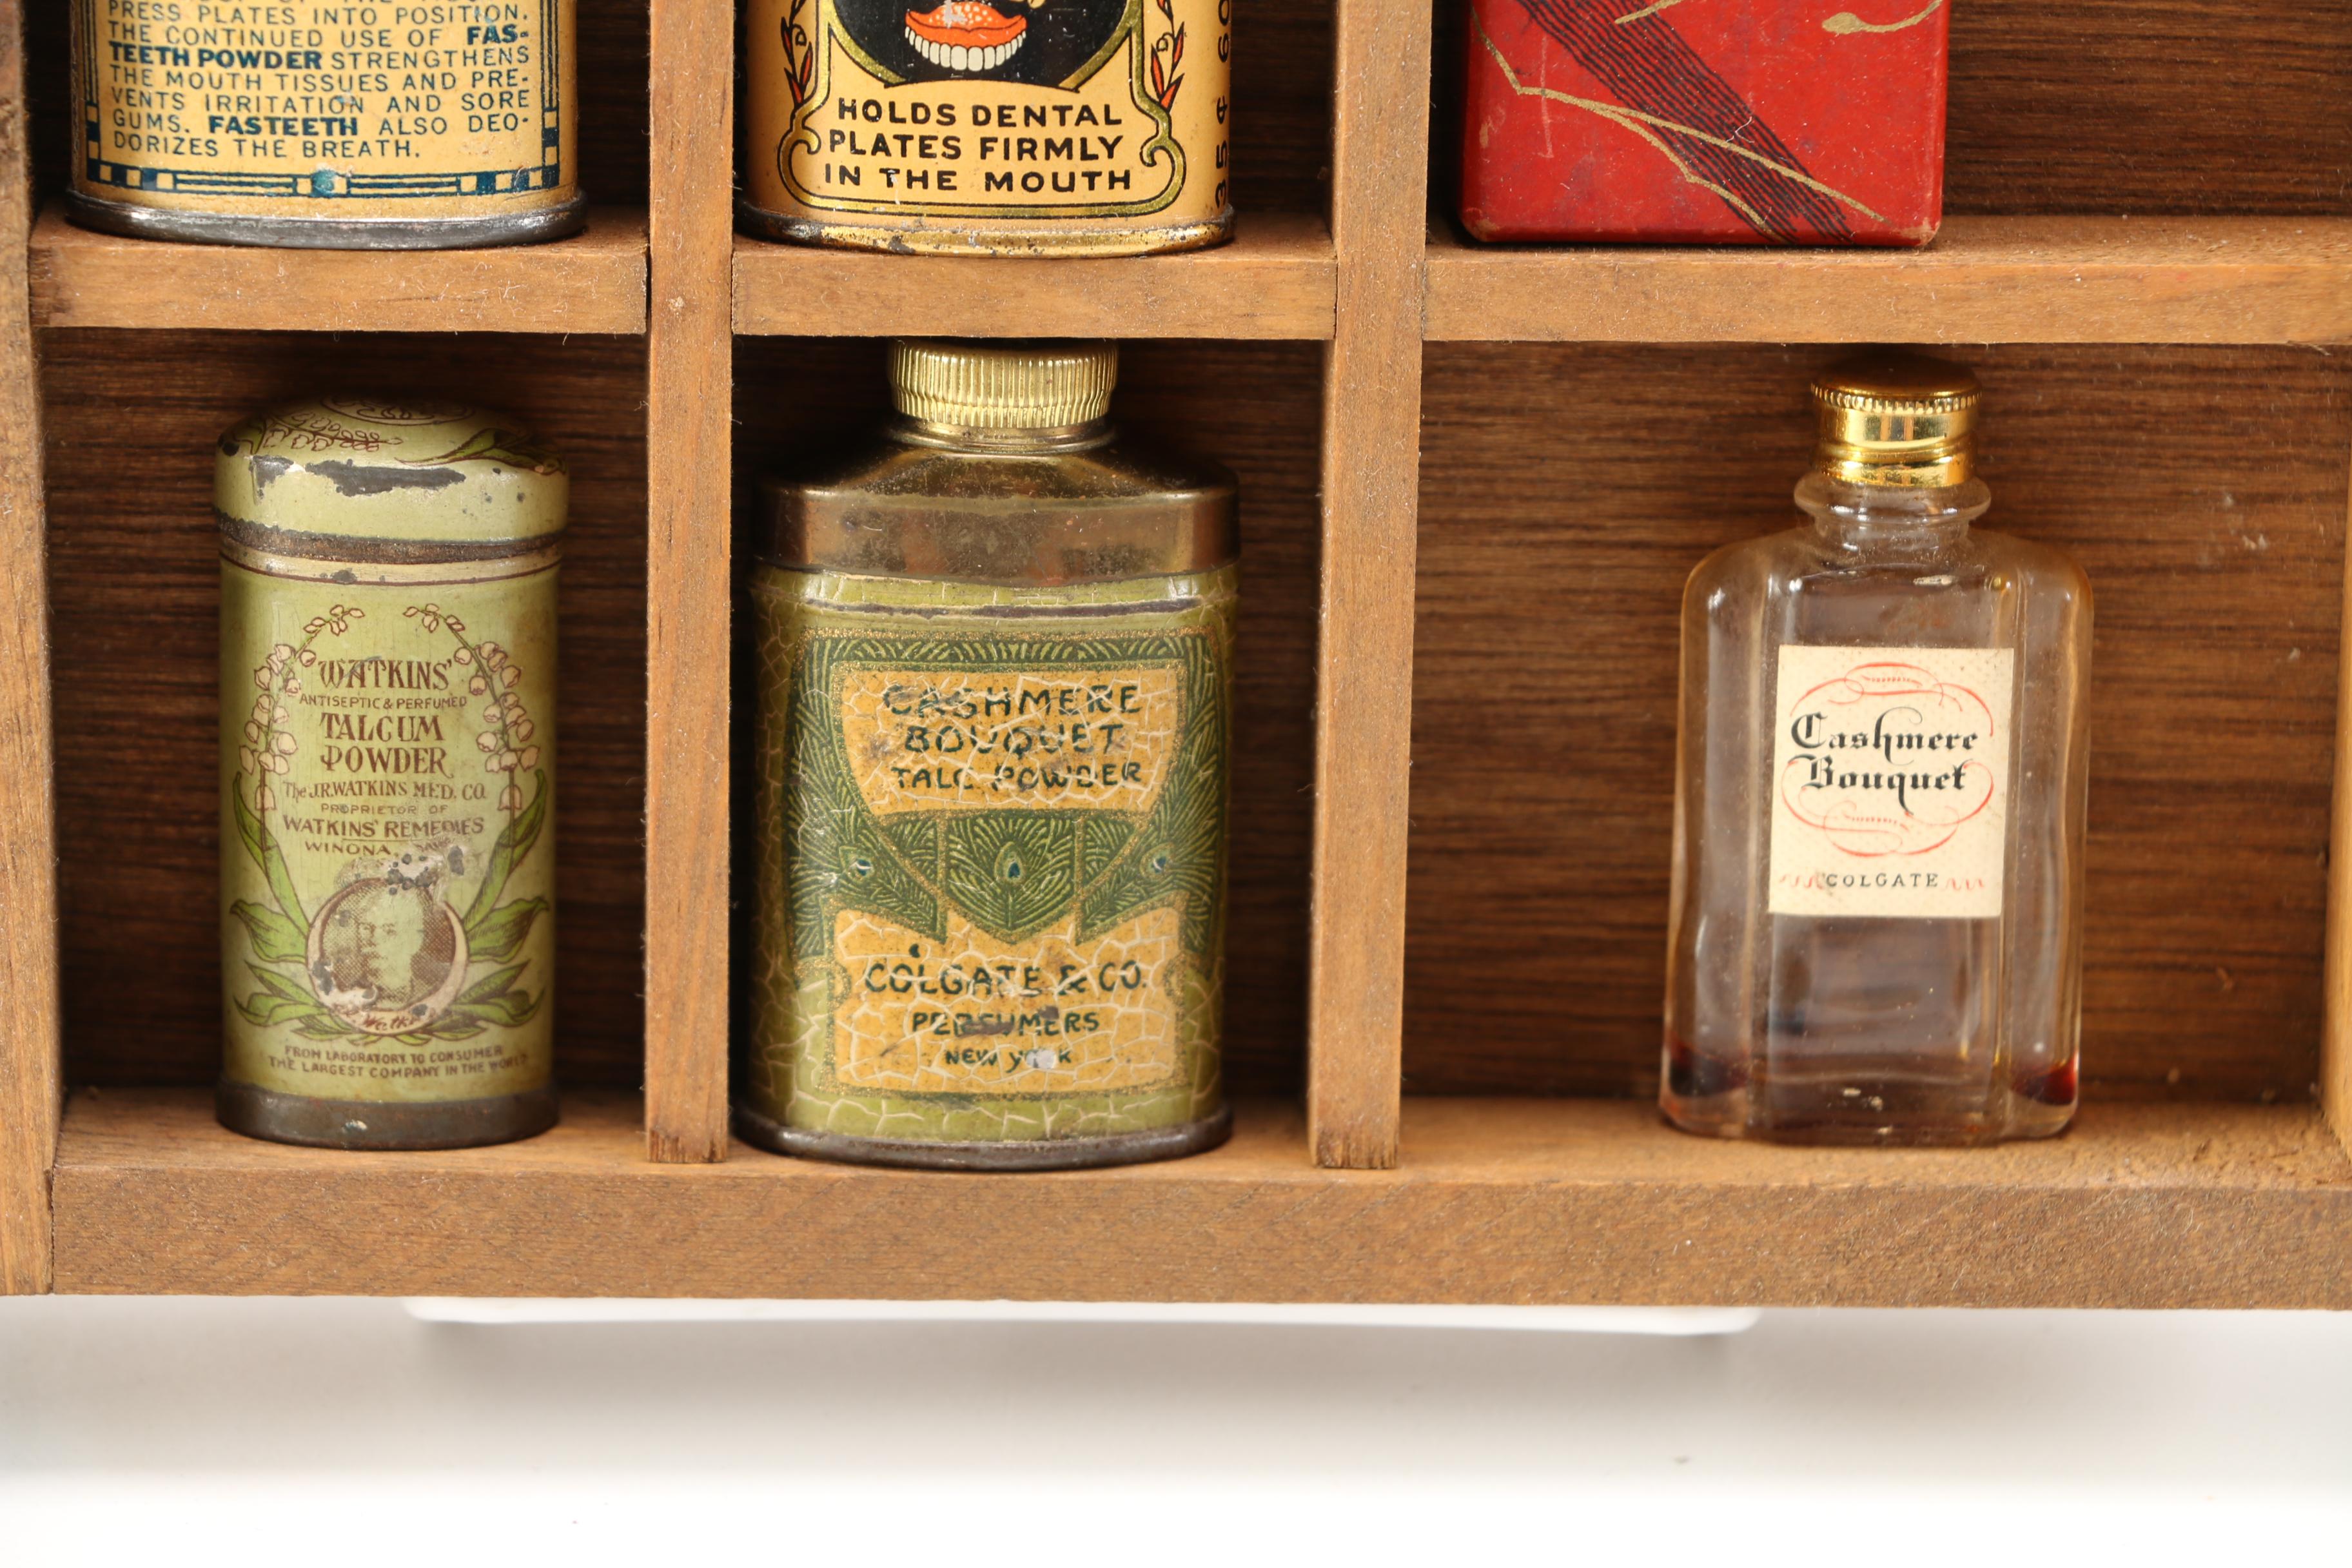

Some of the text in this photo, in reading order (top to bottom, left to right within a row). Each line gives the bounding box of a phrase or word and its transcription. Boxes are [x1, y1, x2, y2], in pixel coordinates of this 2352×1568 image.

[108, 1, 528, 24] PRESS PLATES INTO POSITION.
[108, 21, 529, 48] THE CONTINUED USE OF FAS-
[108, 41, 529, 70] TEETH POWDER STRENGTHENS
[110, 64, 528, 92] THE MOUTH TISSUES AND PRE-
[112, 86, 529, 114] VENTS IRRITATION AND SORE
[838, 97, 1122, 127] HOLDS DENTAL
[113, 109, 529, 136] GUMS. FASTEETH ALSO DEO-
[114, 131, 420, 158] DORIZES THE BREATH.
[830, 129, 1124, 161] PLATES FIRMLY
[825, 163, 1130, 192] IN THE MOUTH
[317, 658, 453, 691] WATKINS'
[299, 692, 467, 709] ANTISEPTIC & PERFUMED
[882, 684, 1143, 719] CASHMERE
[319, 712, 446, 742] TALCUM
[1790, 706, 1979, 766] Cashmere
[905, 723, 1123, 760] BOUQUET
[320, 745, 454, 779] POWDER
[890, 762, 1142, 792] TALC POWDER
[1787, 753, 1974, 816] Bouquet
[282, 781, 306, 803] The
[413, 781, 457, 799] MED.
[462, 782, 487, 801] CO.
[321, 803, 448, 815] PROPRIETOR OF
[282, 815, 484, 838] WATKINS' REMEDIES
[1825, 872, 1939, 888] COLGATE
[865, 959, 1147, 997] COLGATE & CO.
[268, 1055, 296, 1070] THE
[302, 1061, 364, 1077] LARGEST
[369, 1066, 439, 1079] COMPANY
[446, 1064, 458, 1075] IN
[462, 1061, 485, 1074] THE
[284, 1045, 321, 1059] FROM
[410, 1053, 426, 1064] TO
[430, 1044, 504, 1063] CONSUMER
[945, 1048, 1072, 1073] NEW YK
